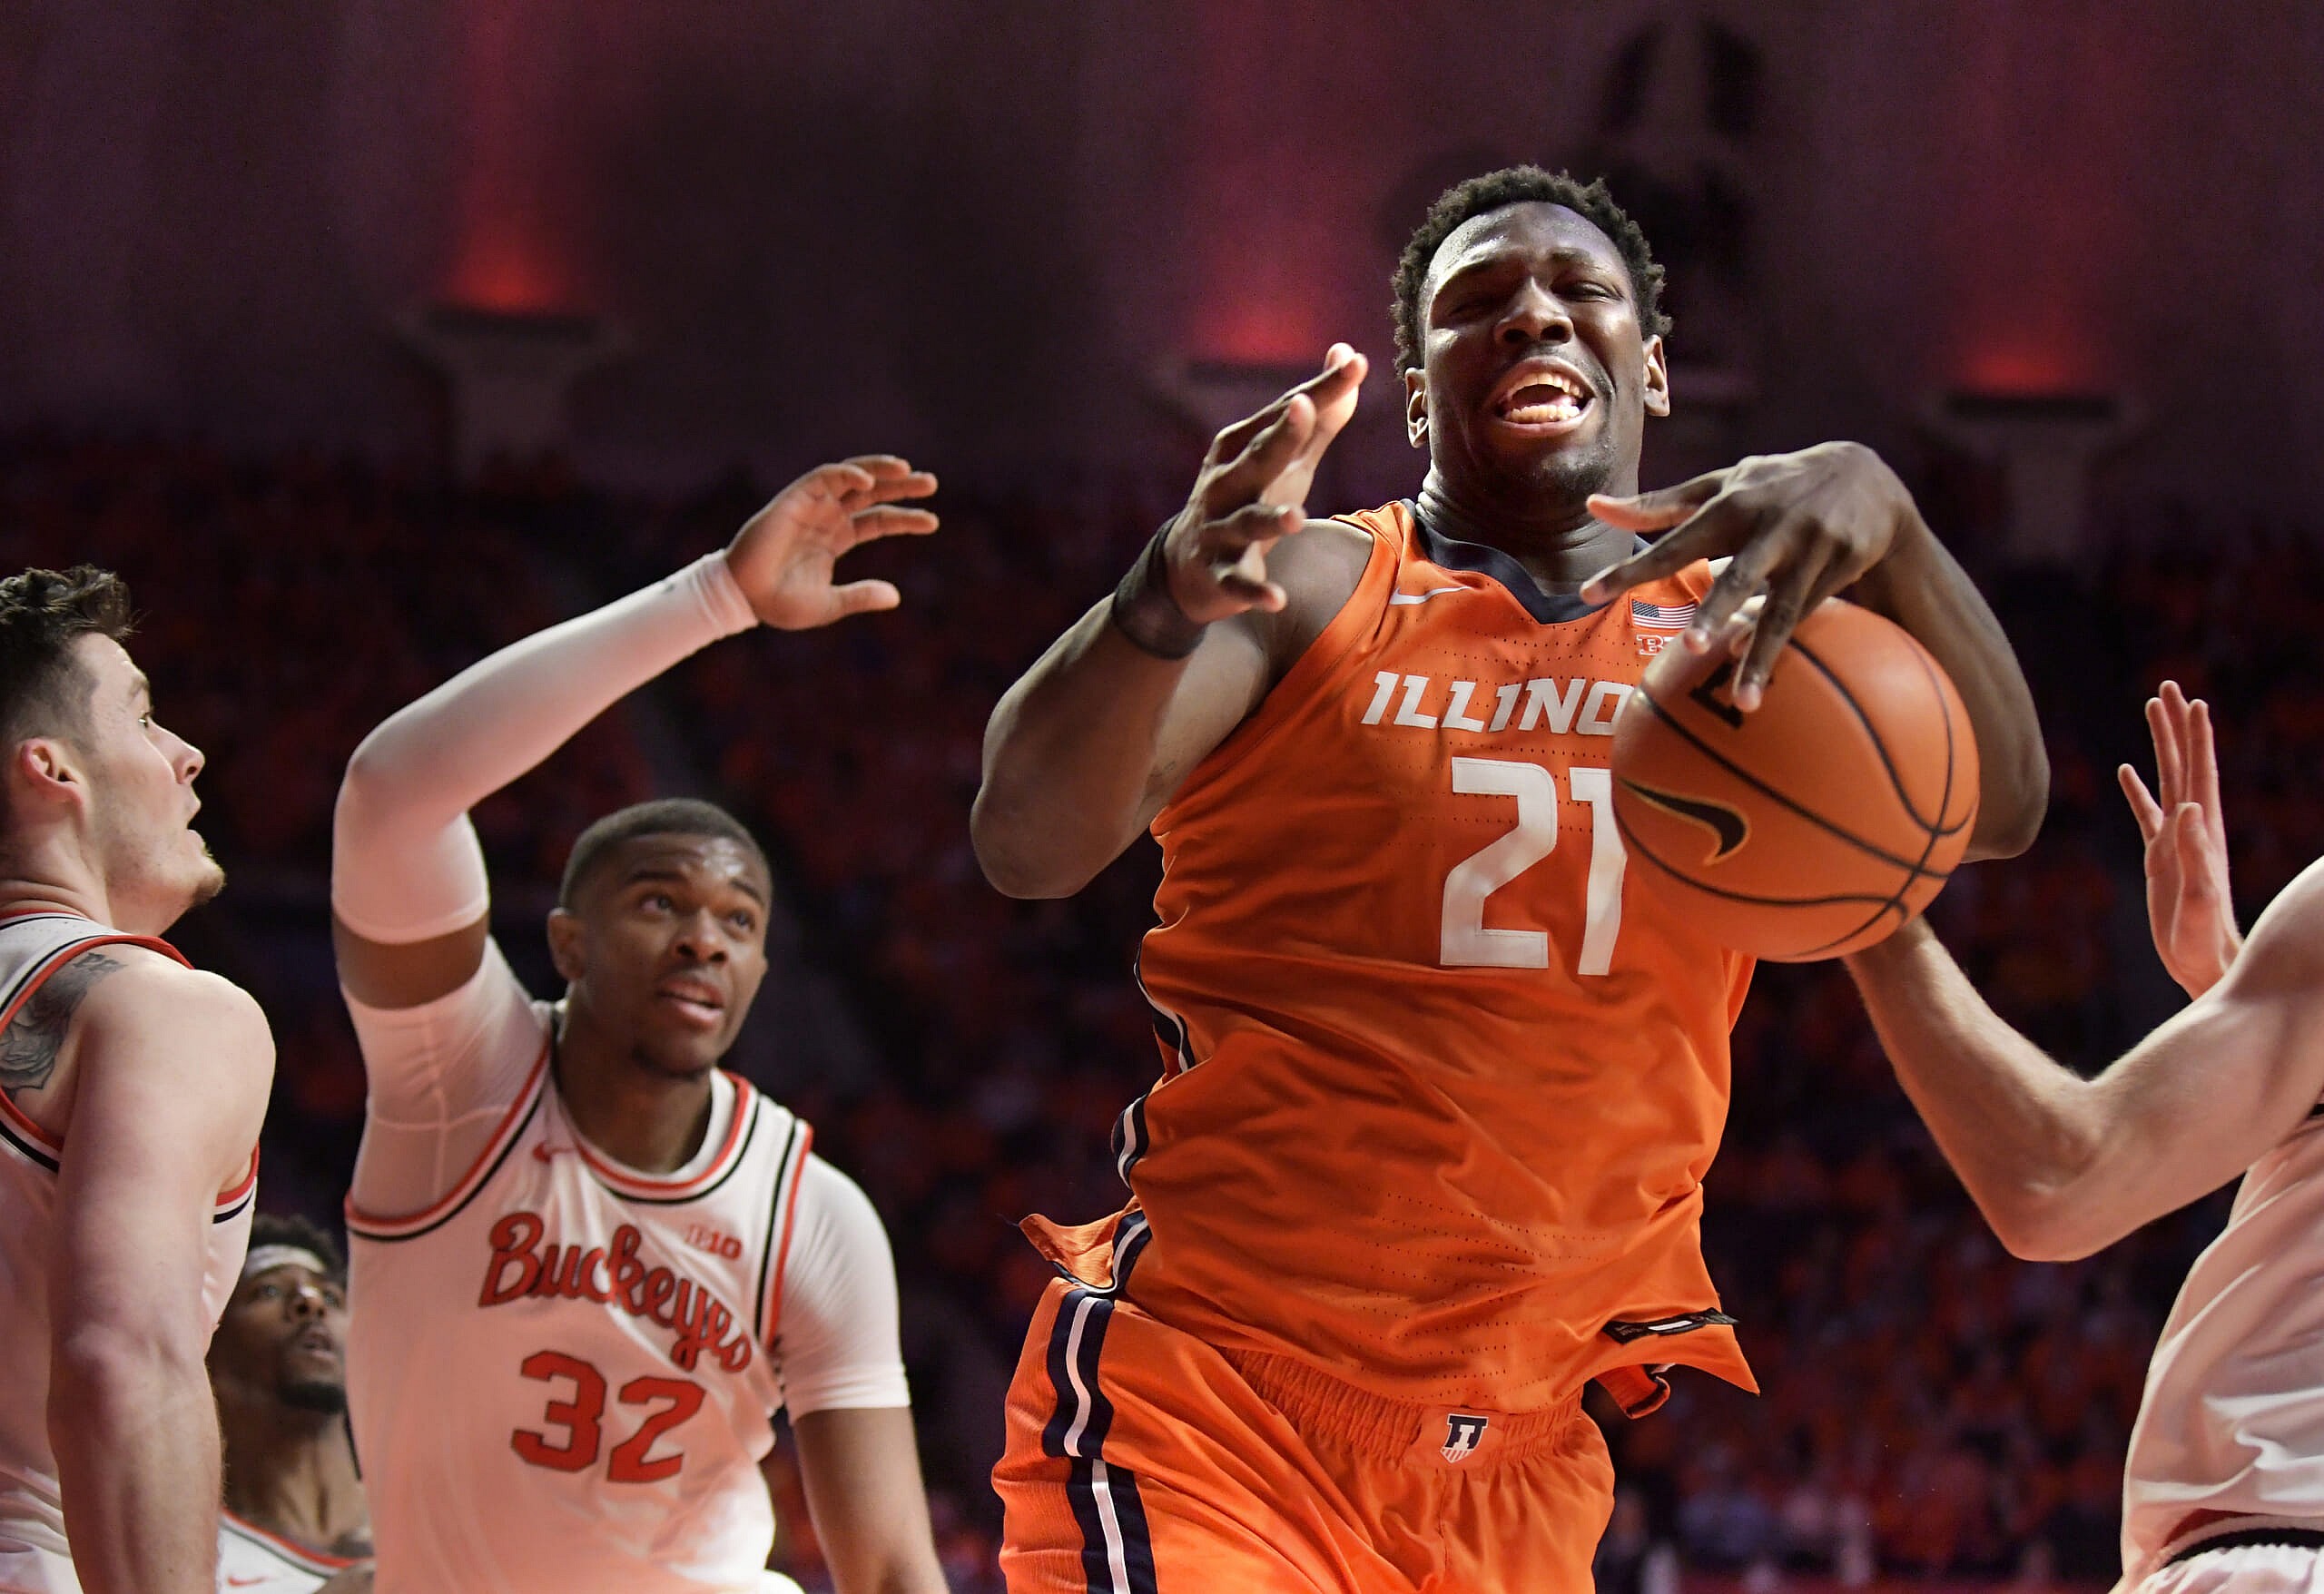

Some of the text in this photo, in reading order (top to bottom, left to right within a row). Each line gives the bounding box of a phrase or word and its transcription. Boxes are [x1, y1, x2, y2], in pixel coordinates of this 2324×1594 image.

[1441, 758, 1627, 975] 21
[478, 1213, 752, 1373] Buckeyes
[511, 1351, 705, 1483] 32
